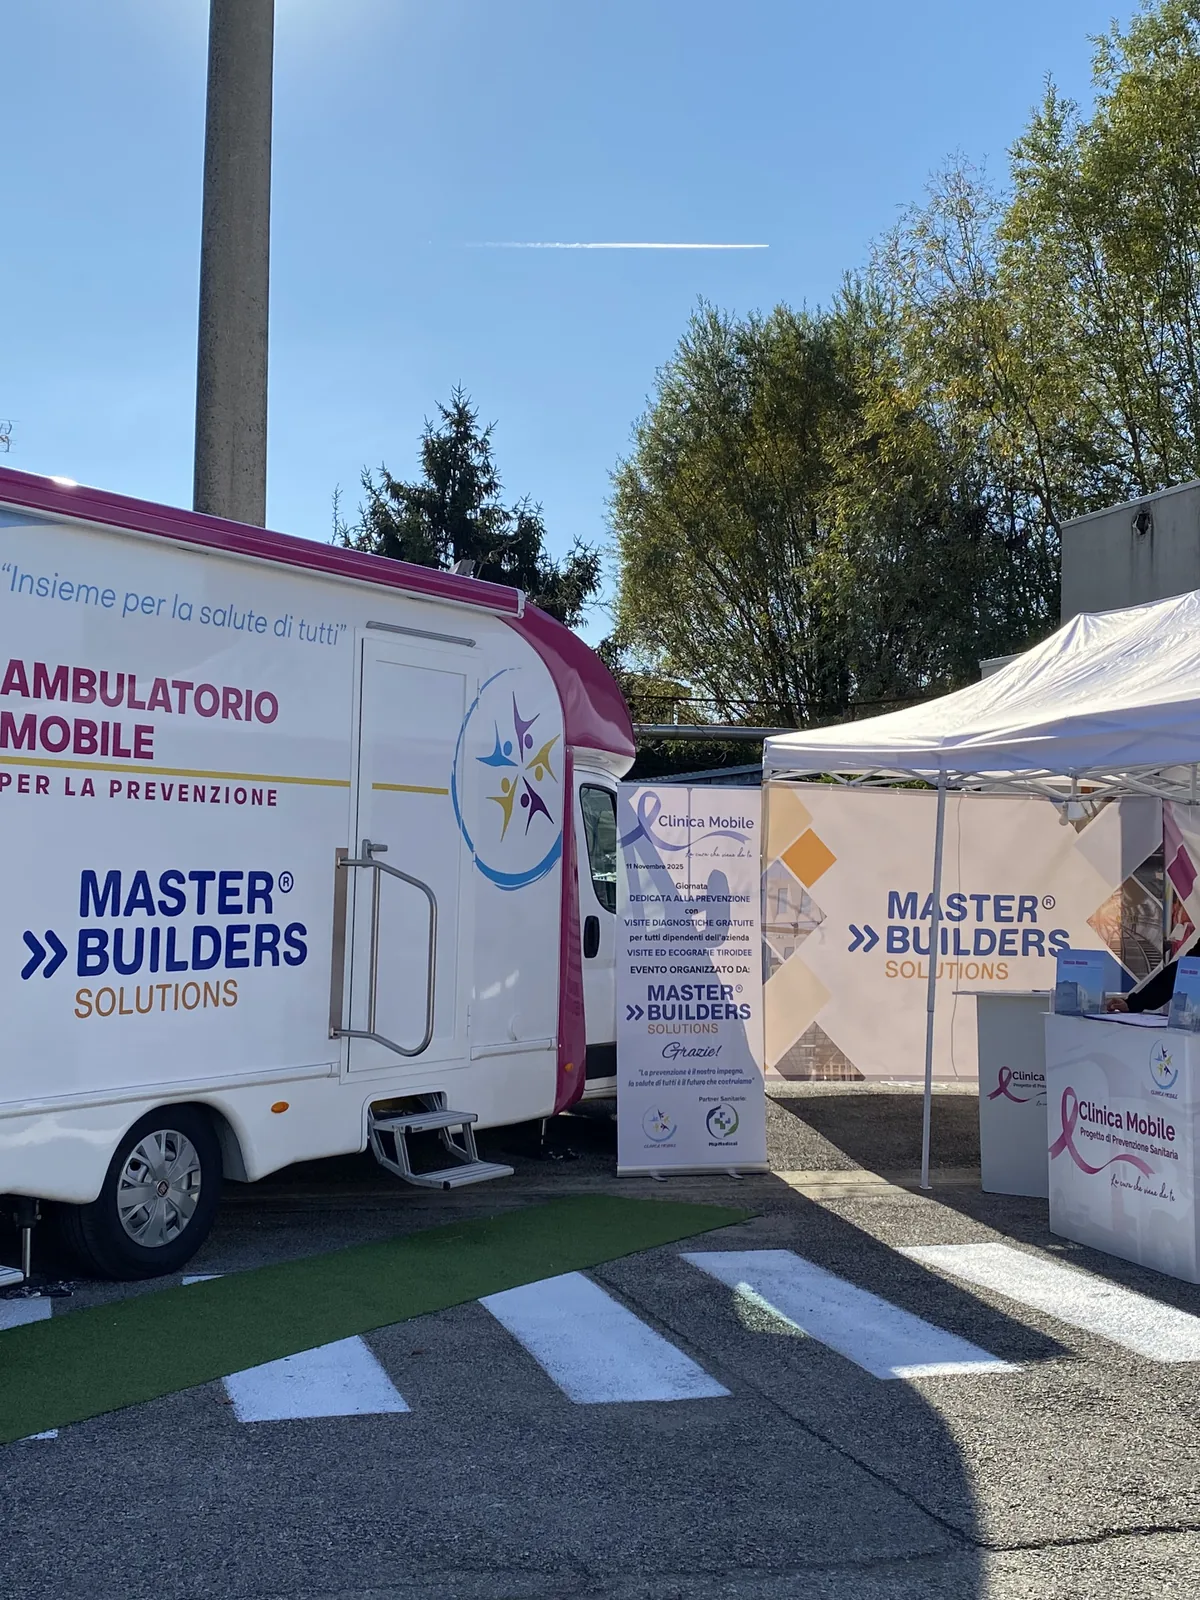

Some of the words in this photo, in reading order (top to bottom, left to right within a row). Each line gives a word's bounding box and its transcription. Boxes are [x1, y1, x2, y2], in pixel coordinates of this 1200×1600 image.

[1, 562, 116, 608] “Insieme
[122, 592, 166, 618] per
[172, 594, 192, 621] la
[200, 604, 267, 634] salute
[274, 615, 293, 638] di
[299, 618, 347, 646] tutti”
[0, 658, 279, 724] AMBULATORIO
[0, 711, 154, 760] MOBILE
[0, 772, 50, 795] PER
[64, 776, 95, 797] LA
[109, 779, 278, 807] PREVENZIONE
[658, 814, 705, 828] Clinica
[709, 816, 754, 829] Mobile
[77, 922, 308, 977] BUILDERS
[644, 934, 661, 942] tutti
[662, 934, 704, 942] dipendenti
[705, 934, 750, 942] dell'azienda
[886, 925, 1071, 958] BUILDERS
[670, 966, 734, 974] ORGANIZZATO
[736, 966, 750, 974] DA:
[74, 979, 239, 1019] SOLUTIONS
[648, 1004, 752, 1020] BUILDERS
[648, 1024, 718, 1034] SOLUTIONS
[662, 1042, 722, 1060] Grazie!
[649, 1069, 687, 1077] prevenzione
[1012, 1071, 1045, 1082] Clinica
[1078, 1100, 1123, 1130] Clinica
[1126, 1110, 1176, 1142] Mobile
[1080, 1127, 1104, 1142] Progetto
[1106, 1132, 1112, 1144] di
[1112, 1134, 1149, 1153] Prevenzione
[1150, 1144, 1178, 1160] Sanitaria
[1111, 1174, 1120, 1188] La
[1134, 1176, 1142, 1192] che
